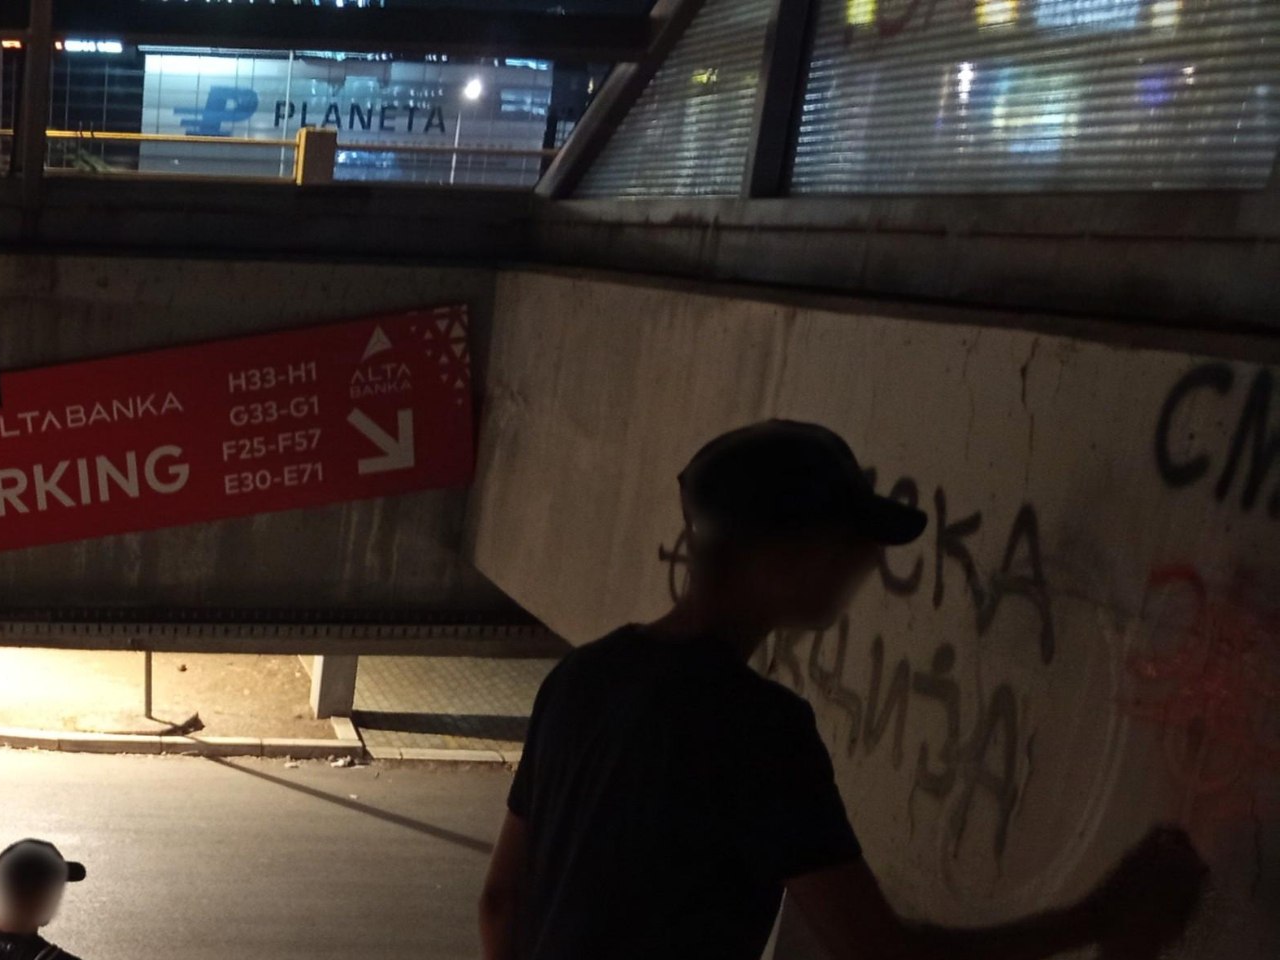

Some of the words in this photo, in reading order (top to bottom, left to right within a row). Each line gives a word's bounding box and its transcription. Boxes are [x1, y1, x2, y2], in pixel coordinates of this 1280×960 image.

[274, 99, 447, 133] PLANETA
[228, 361, 318, 394] H33-H1
[350, 379, 413, 399] BANKA
[351, 362, 412, 384] ALTA
[229, 396, 320, 426] G33-G1
[222, 428, 322, 462] F25-F57
[224, 462, 324, 495] E30-E71
